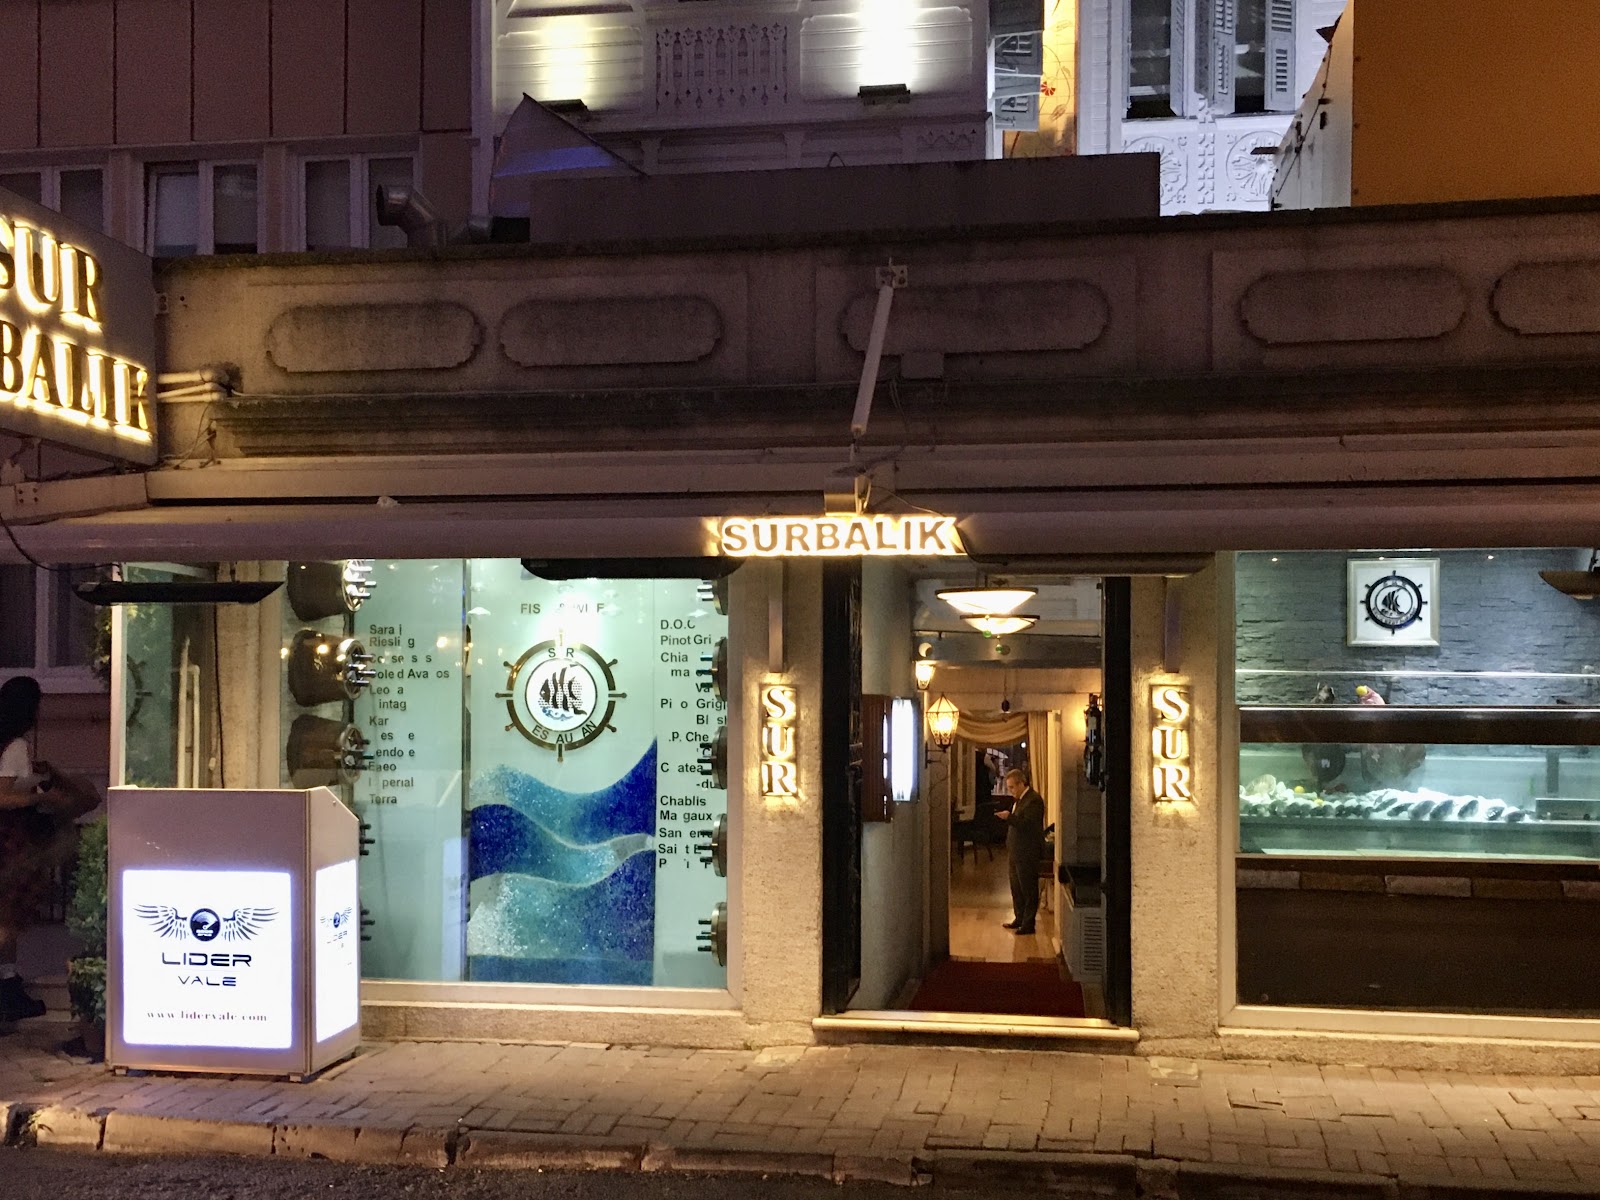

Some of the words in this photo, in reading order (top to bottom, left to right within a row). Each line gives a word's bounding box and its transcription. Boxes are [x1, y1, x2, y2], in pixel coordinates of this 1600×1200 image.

[722, 520, 947, 553] SURBALIK
[660, 634, 691, 646] Pinot
[764, 688, 796, 794] SUR
[1155, 689, 1193, 799] SUR
[369, 793, 398, 805] Terra
[660, 795, 707, 807] Chablis
[161, 951, 253, 968] LIDER
[177, 975, 237, 987] VALE
